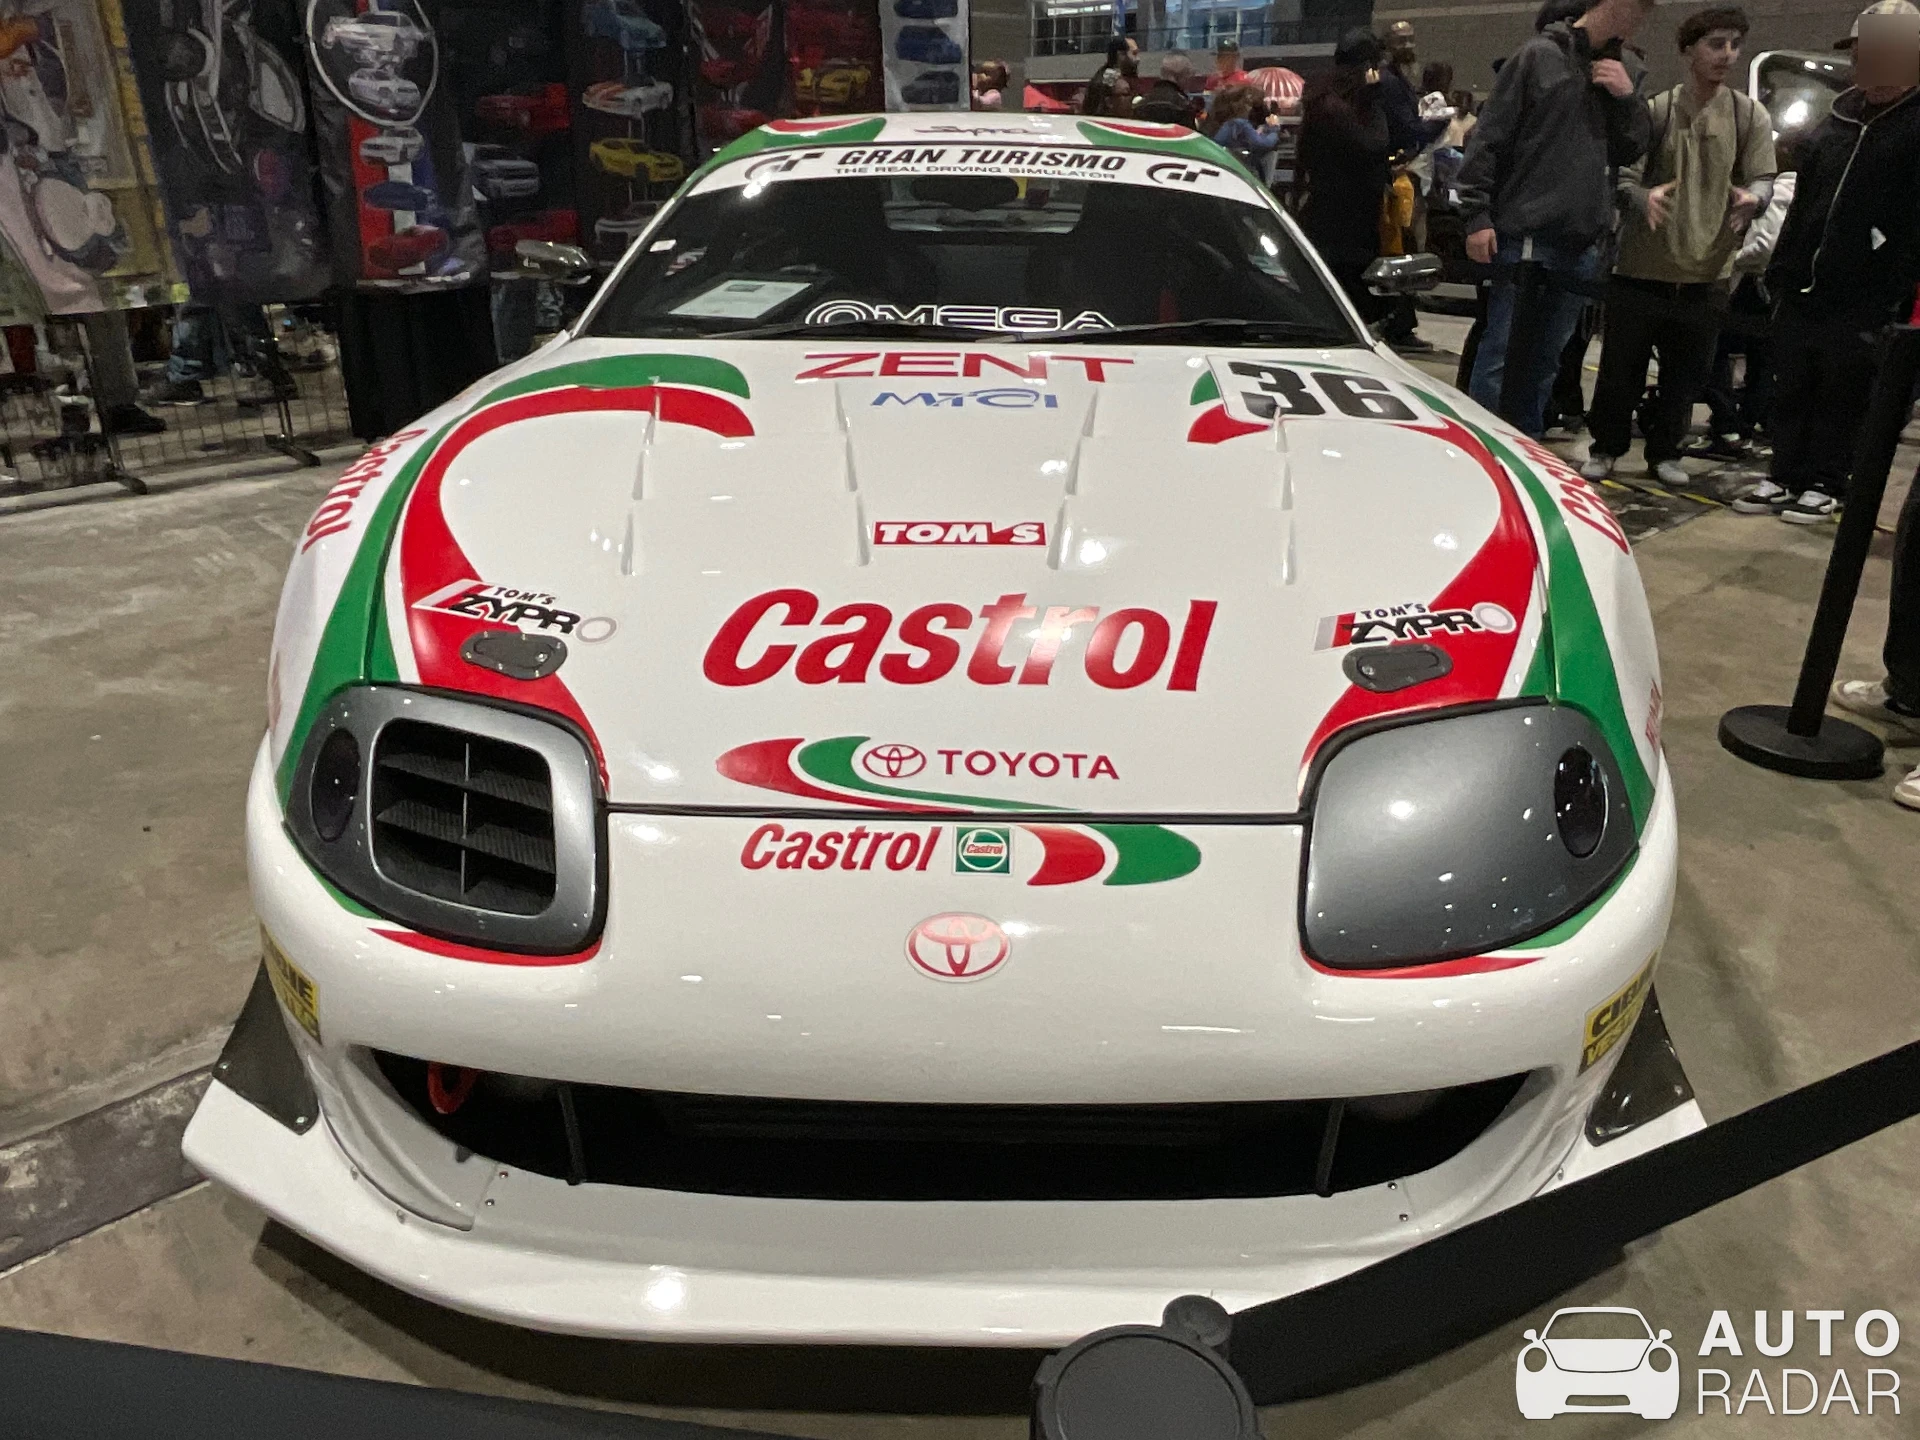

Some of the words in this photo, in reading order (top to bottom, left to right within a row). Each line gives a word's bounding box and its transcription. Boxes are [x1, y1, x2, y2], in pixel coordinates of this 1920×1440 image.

[837, 149, 947, 165] GRAN
[958, 149, 1127, 171] TURISMO
[1009, 167, 1115, 179] SIMULATOR
[804, 299, 1116, 333] OMEGA
[795, 351, 1134, 383] ZENT
[1227, 361, 1419, 420] 36
[301, 428, 428, 556] Castrol
[493, 586, 556, 606] TOM'S
[1361, 602, 1427, 620] TOM'S
[703, 588, 1218, 692] Castrol
[937, 749, 1120, 780] TOYOTA
[740, 822, 943, 872] Castrol
[966, 844, 1004, 855] Castrol
